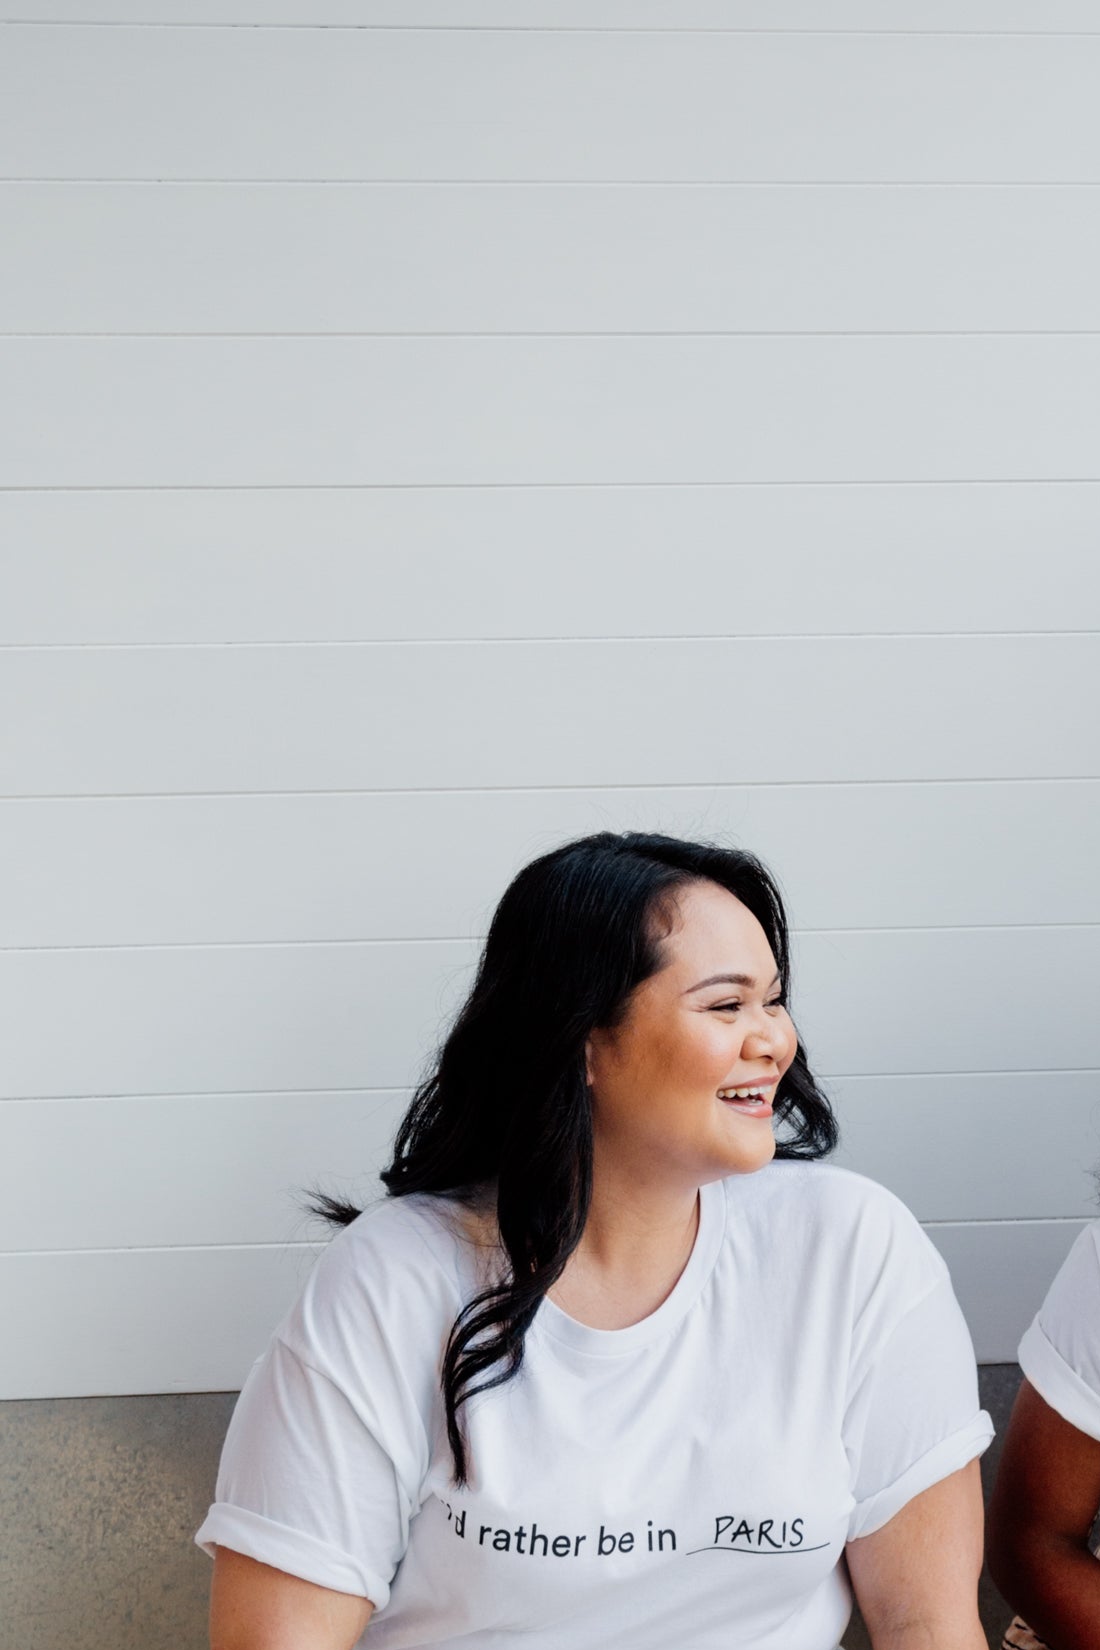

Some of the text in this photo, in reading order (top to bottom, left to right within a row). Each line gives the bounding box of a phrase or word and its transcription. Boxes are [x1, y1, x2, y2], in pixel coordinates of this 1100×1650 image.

[479, 1523, 587, 1558] rather
[597, 1525, 635, 1556] be
[647, 1520, 677, 1552] in
[713, 1515, 804, 1549] PARIS
